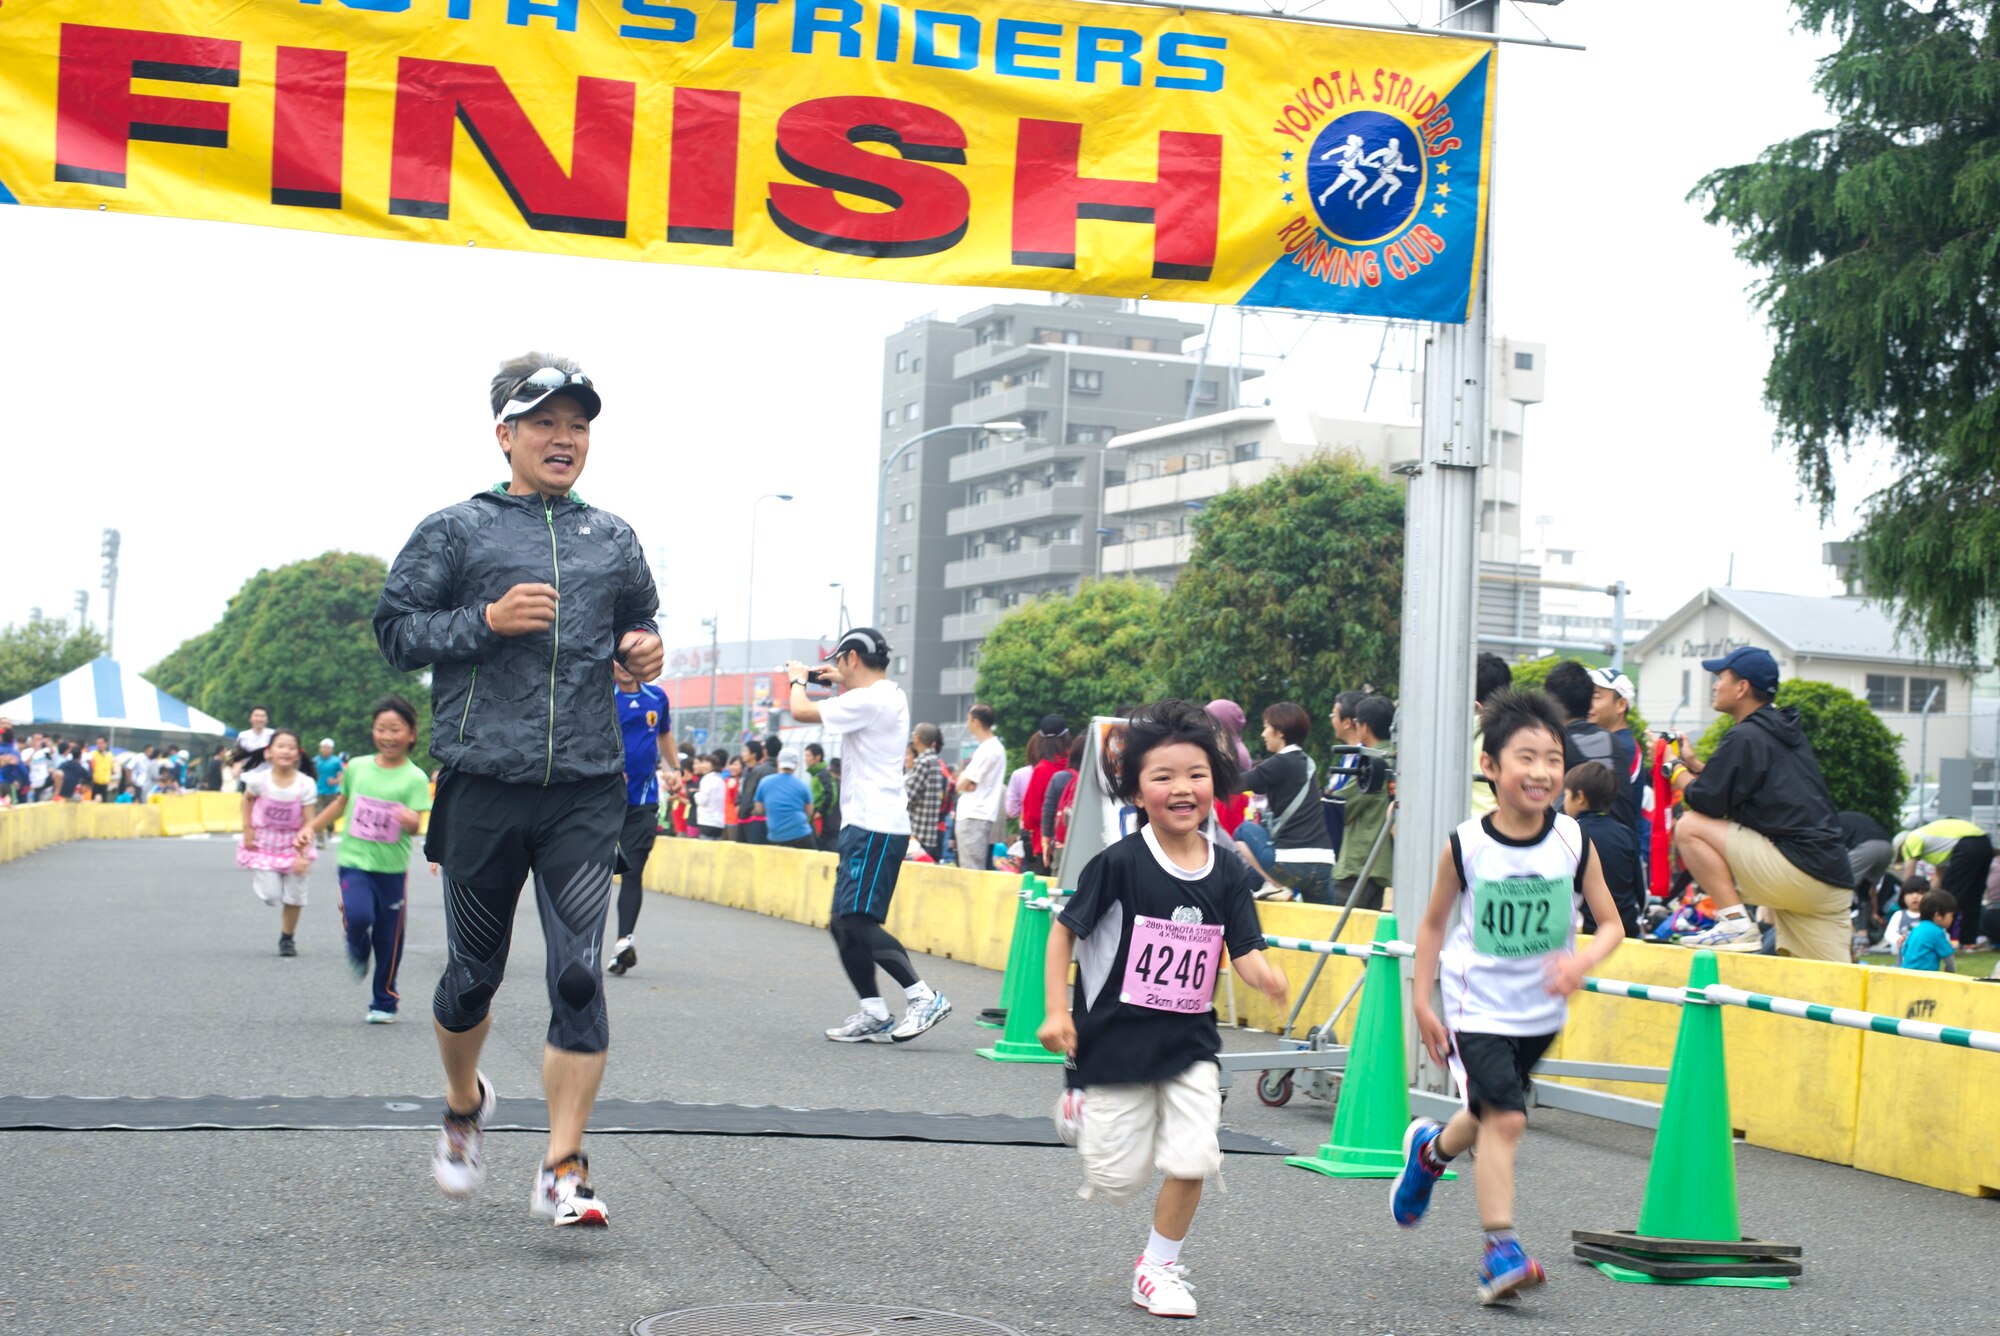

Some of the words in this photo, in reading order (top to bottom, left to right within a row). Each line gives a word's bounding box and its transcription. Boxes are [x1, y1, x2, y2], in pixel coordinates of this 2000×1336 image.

[620, 0, 1227, 93] STRIDERS
[1274, 69, 1365, 143] YOKOTA
[1371, 68, 1462, 158] STRIDERS
[55, 23, 1223, 282] FINISH
[1277, 215, 1382, 288] RUNNING
[1383, 223, 1446, 281] CLUB
[1145, 919, 1163, 930] 28th
[1165, 923, 1194, 935] YOKOTA
[1481, 899, 1550, 937] 4072
[1135, 943, 1208, 990] 4246
[1145, 993, 1173, 1008] 2km
[1175, 997, 1201, 1011] KIDS
